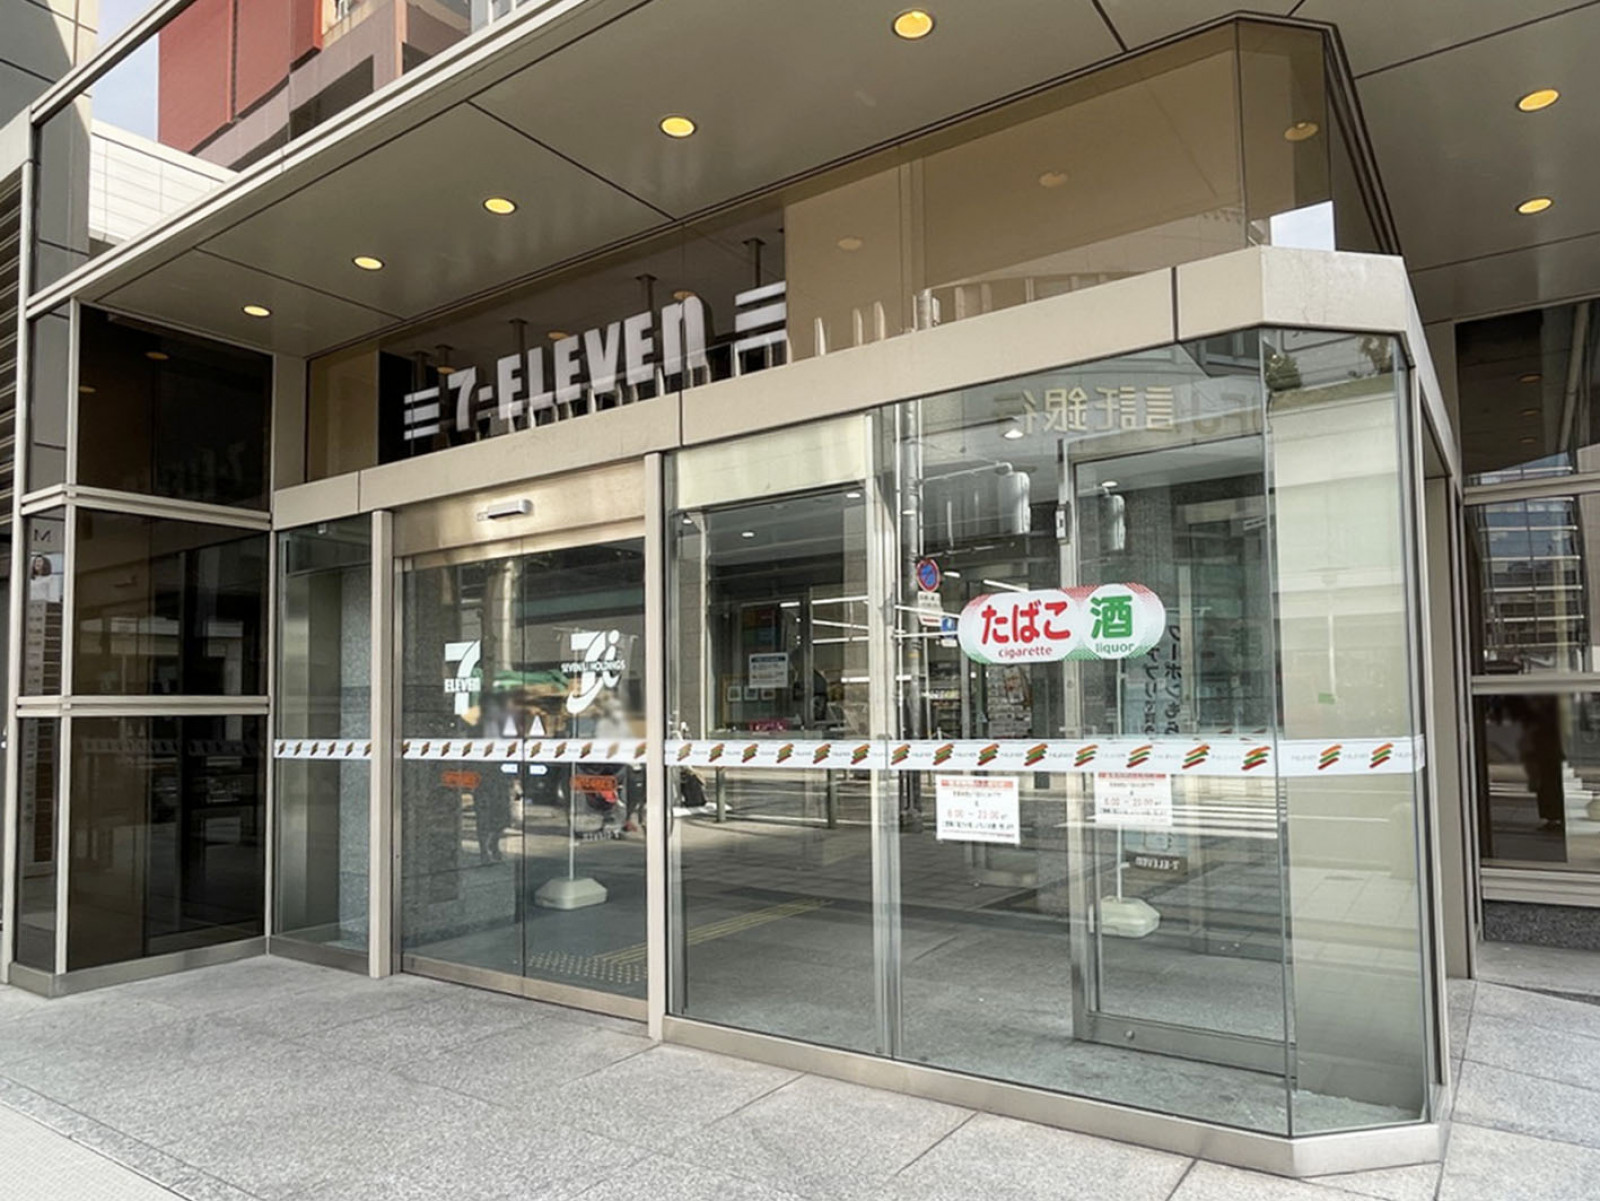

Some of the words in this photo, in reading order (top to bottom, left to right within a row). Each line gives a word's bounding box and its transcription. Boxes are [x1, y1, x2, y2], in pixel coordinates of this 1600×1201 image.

[981, 599, 1071, 644] たばこ
[1090, 595, 1133, 639] 酒
[998, 645, 1053, 660] cigarette
[1095, 642, 1134, 656] liquor
